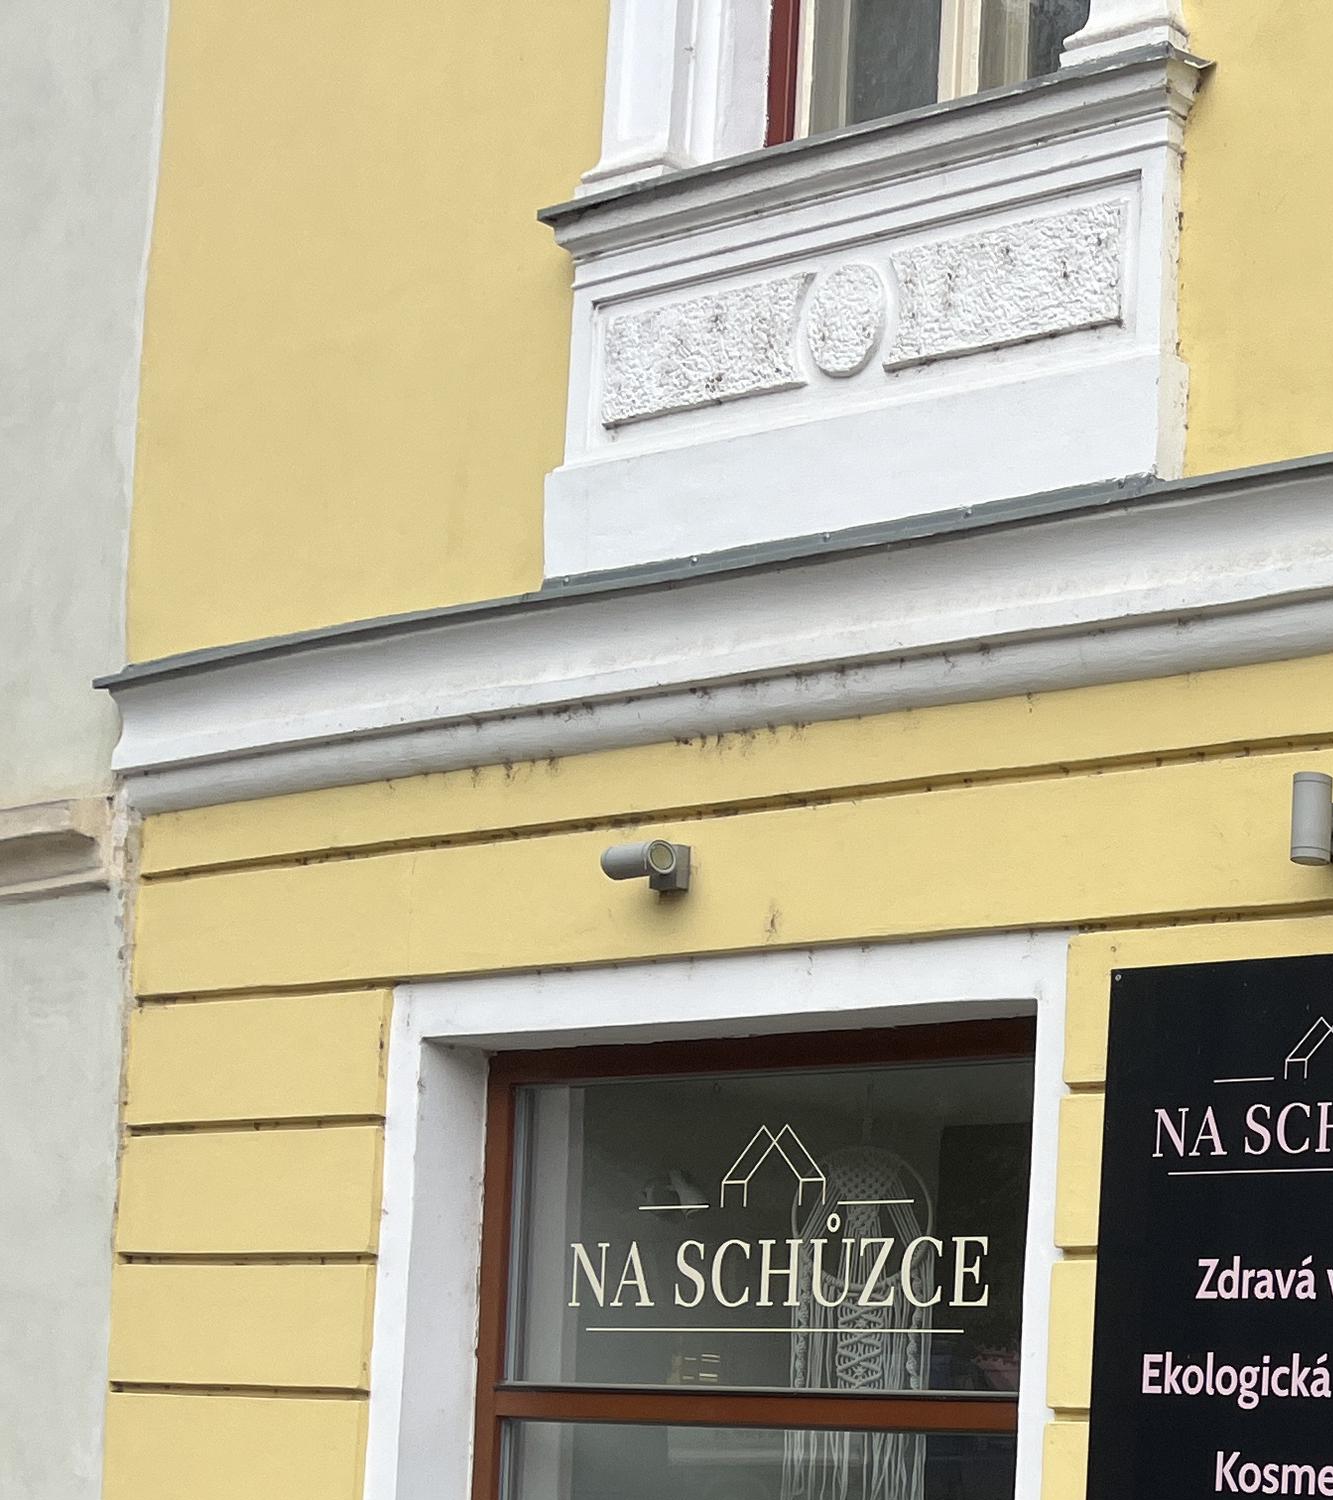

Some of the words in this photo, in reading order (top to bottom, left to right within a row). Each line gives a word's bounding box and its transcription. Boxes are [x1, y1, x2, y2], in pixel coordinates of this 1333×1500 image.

[1152, 1106, 1227, 1158] NA
[568, 1240, 655, 1309] NA
[674, 1213, 989, 1309] SCHŮZCE
[1195, 1255, 1316, 1300] Zdravá
[1140, 1351, 1332, 1410] Ekologická
